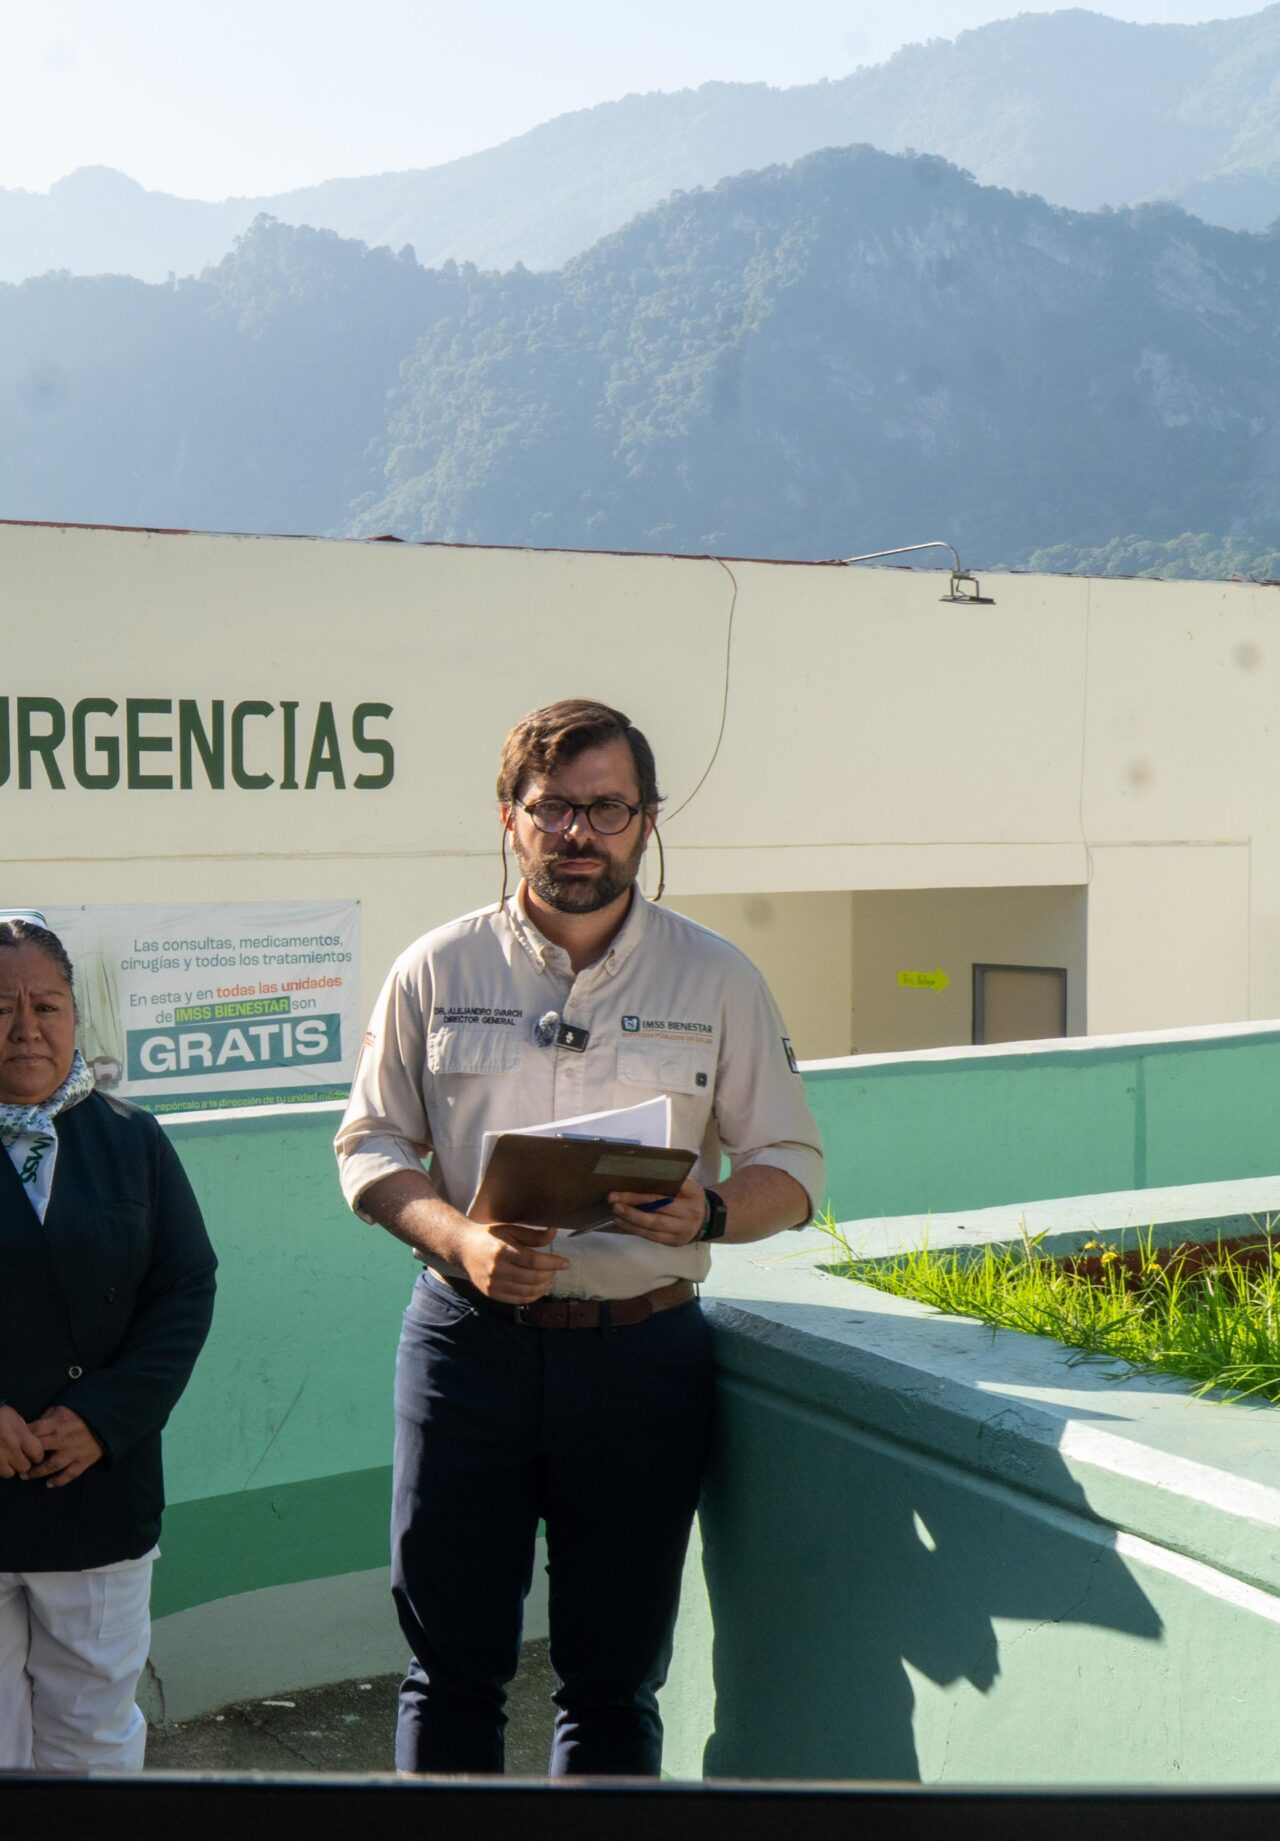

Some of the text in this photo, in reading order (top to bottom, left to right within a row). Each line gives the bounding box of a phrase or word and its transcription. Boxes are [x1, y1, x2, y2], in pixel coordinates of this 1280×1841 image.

[134, 935, 344, 952] Las consultas, medicamentos,
[120, 951, 353, 973] cirugías y todos los tratamientos
[130, 976, 343, 1007] En esta y en todas las unidades
[155, 998, 317, 1024] de IMSS BIENESTAR son
[443, 1015, 516, 1026] DIRECTOR GENERAL
[448, 1007, 492, 1016] ALEJANDRO
[642, 1020, 713, 1034] IMSS BIENESTAR
[139, 1019, 329, 1074] GRATIS
[20, 1134, 55, 1183] IMSS
